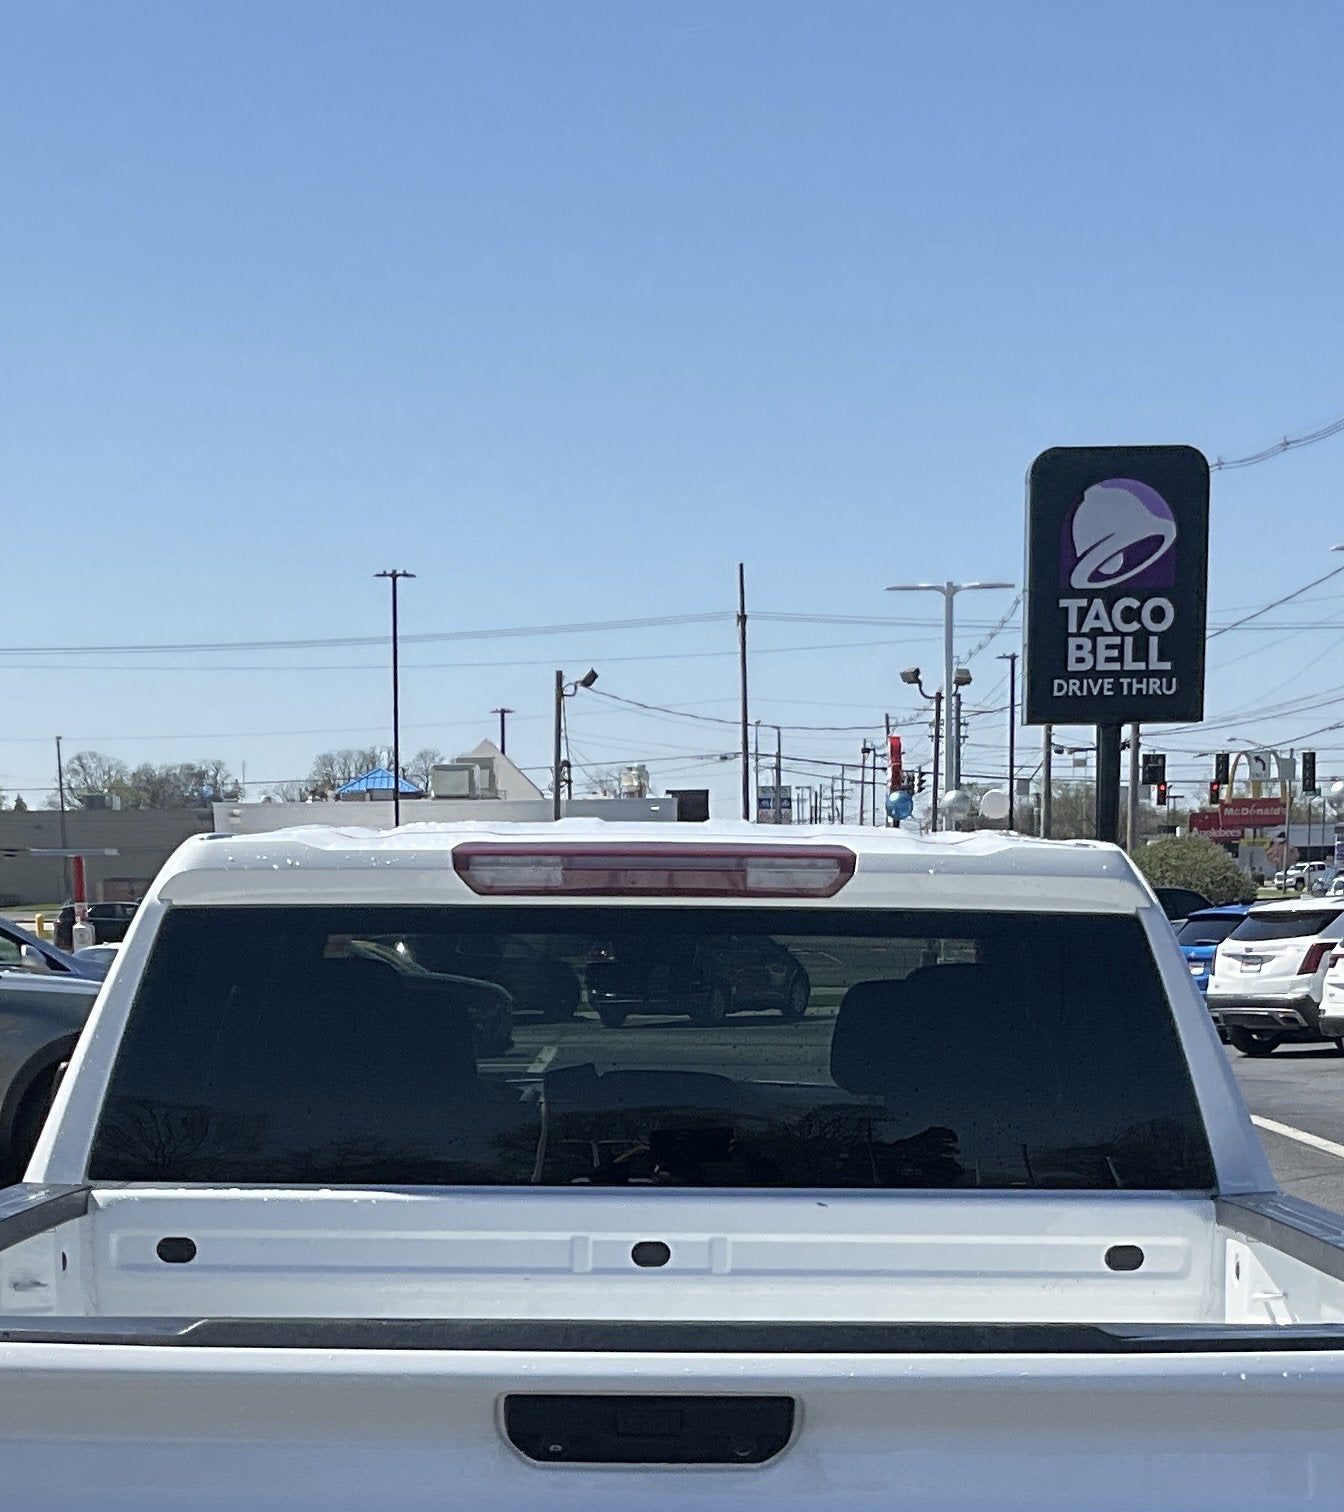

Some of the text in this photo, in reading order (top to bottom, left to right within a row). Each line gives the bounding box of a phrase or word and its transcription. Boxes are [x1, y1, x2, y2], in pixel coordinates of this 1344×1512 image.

[1059, 597, 1175, 633] TACO
[1067, 635, 1172, 671] BELL
[1052, 677, 1178, 697] DRIVE THRU
